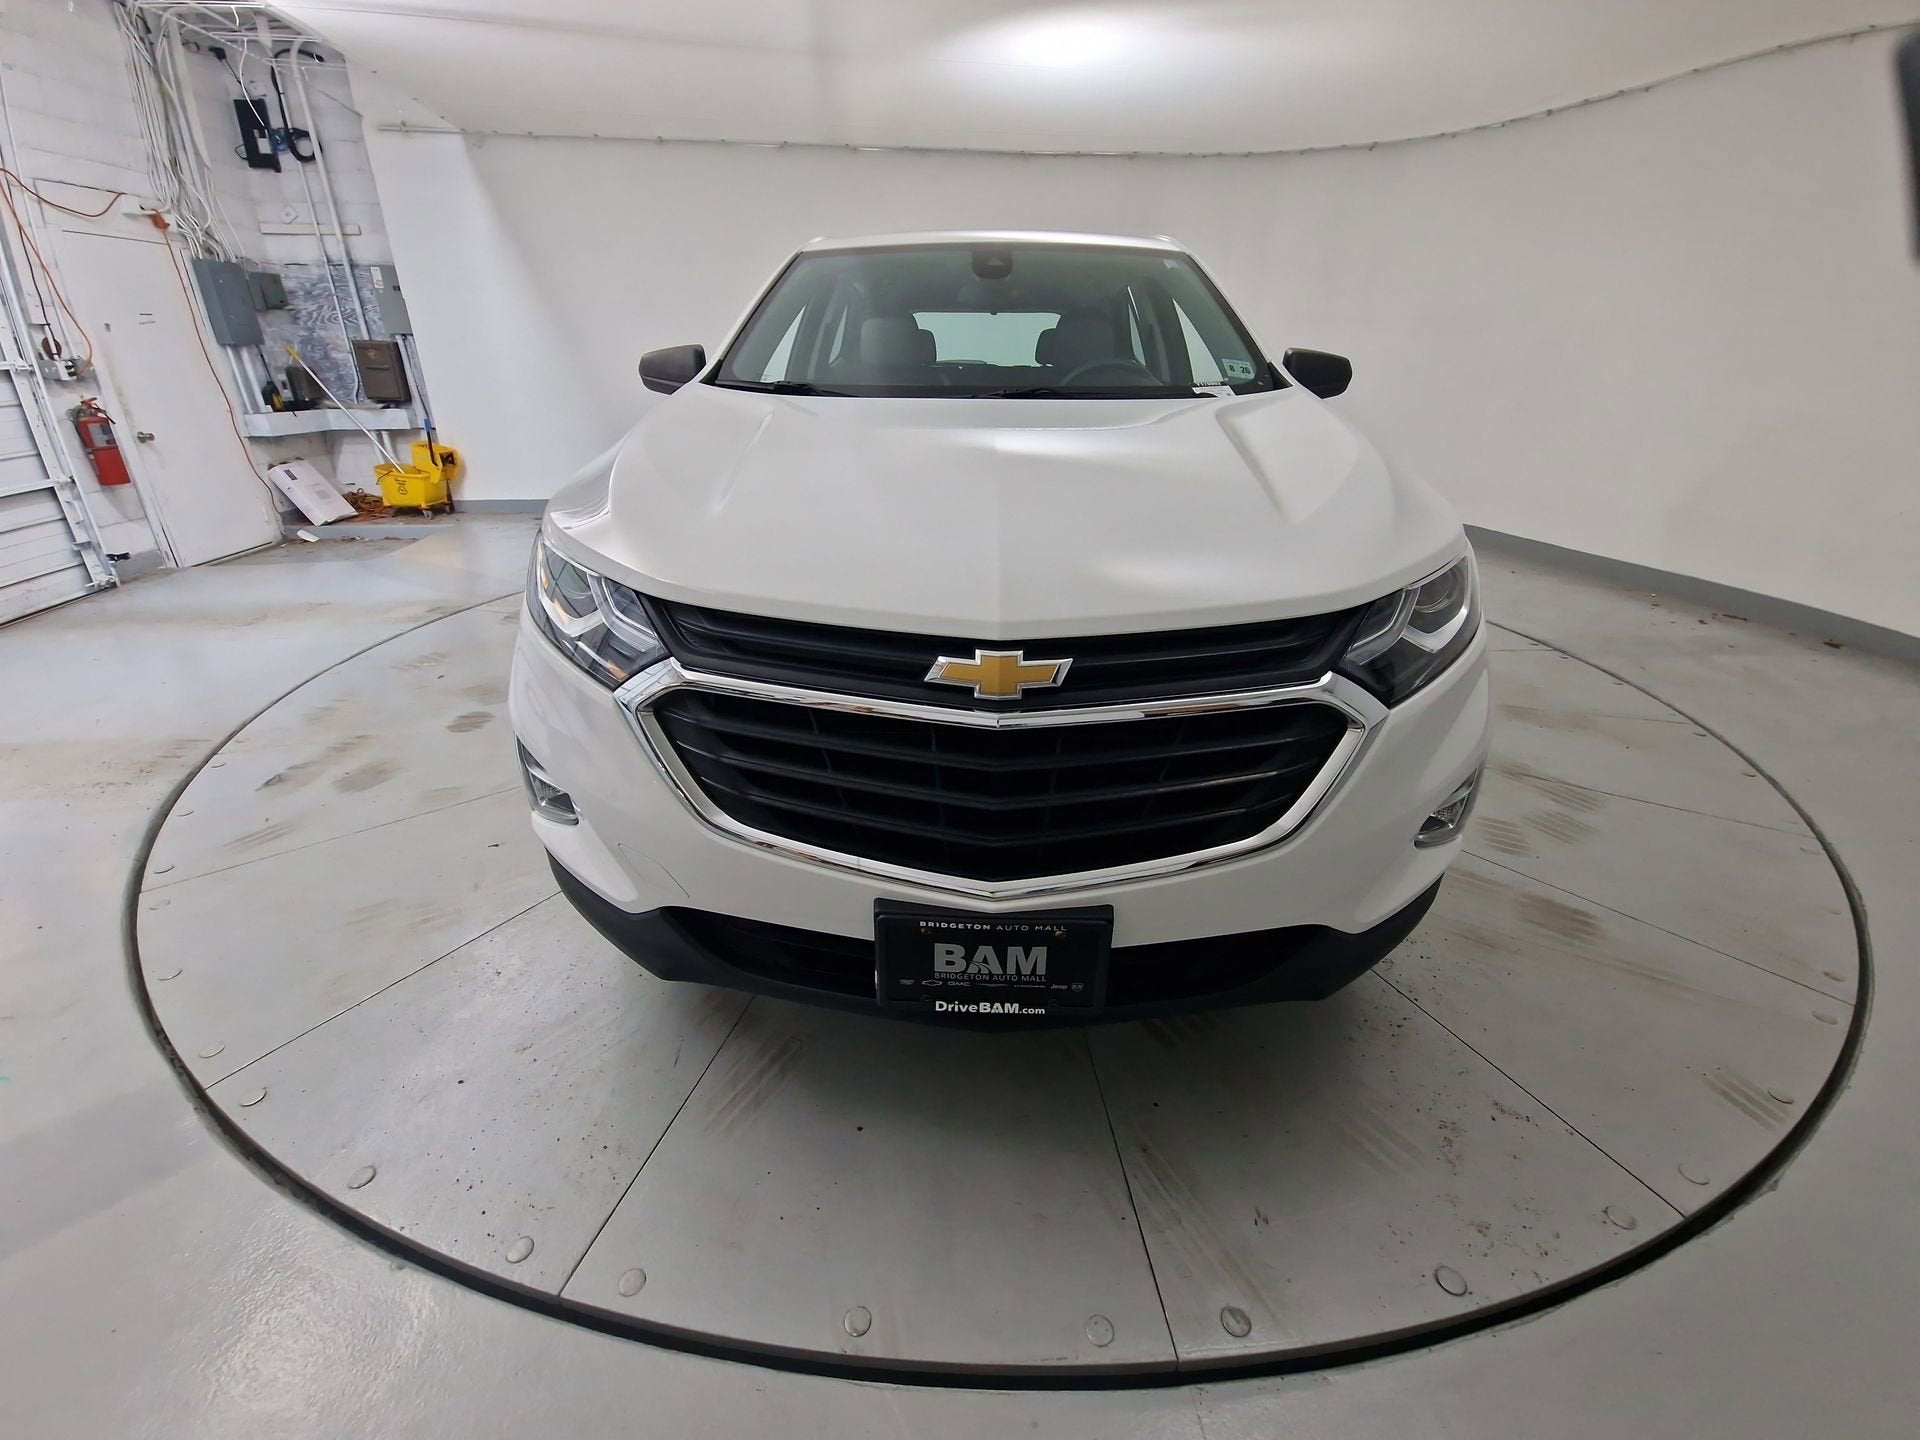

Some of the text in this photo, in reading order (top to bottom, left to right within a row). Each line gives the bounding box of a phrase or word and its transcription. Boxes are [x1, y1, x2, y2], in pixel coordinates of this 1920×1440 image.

[919, 921, 991, 930] BRIDGETON
[934, 943, 1048, 975] BAM
[934, 973, 989, 981] BRIDGETON
[935, 1001, 1046, 1014] DriveBAM.com
